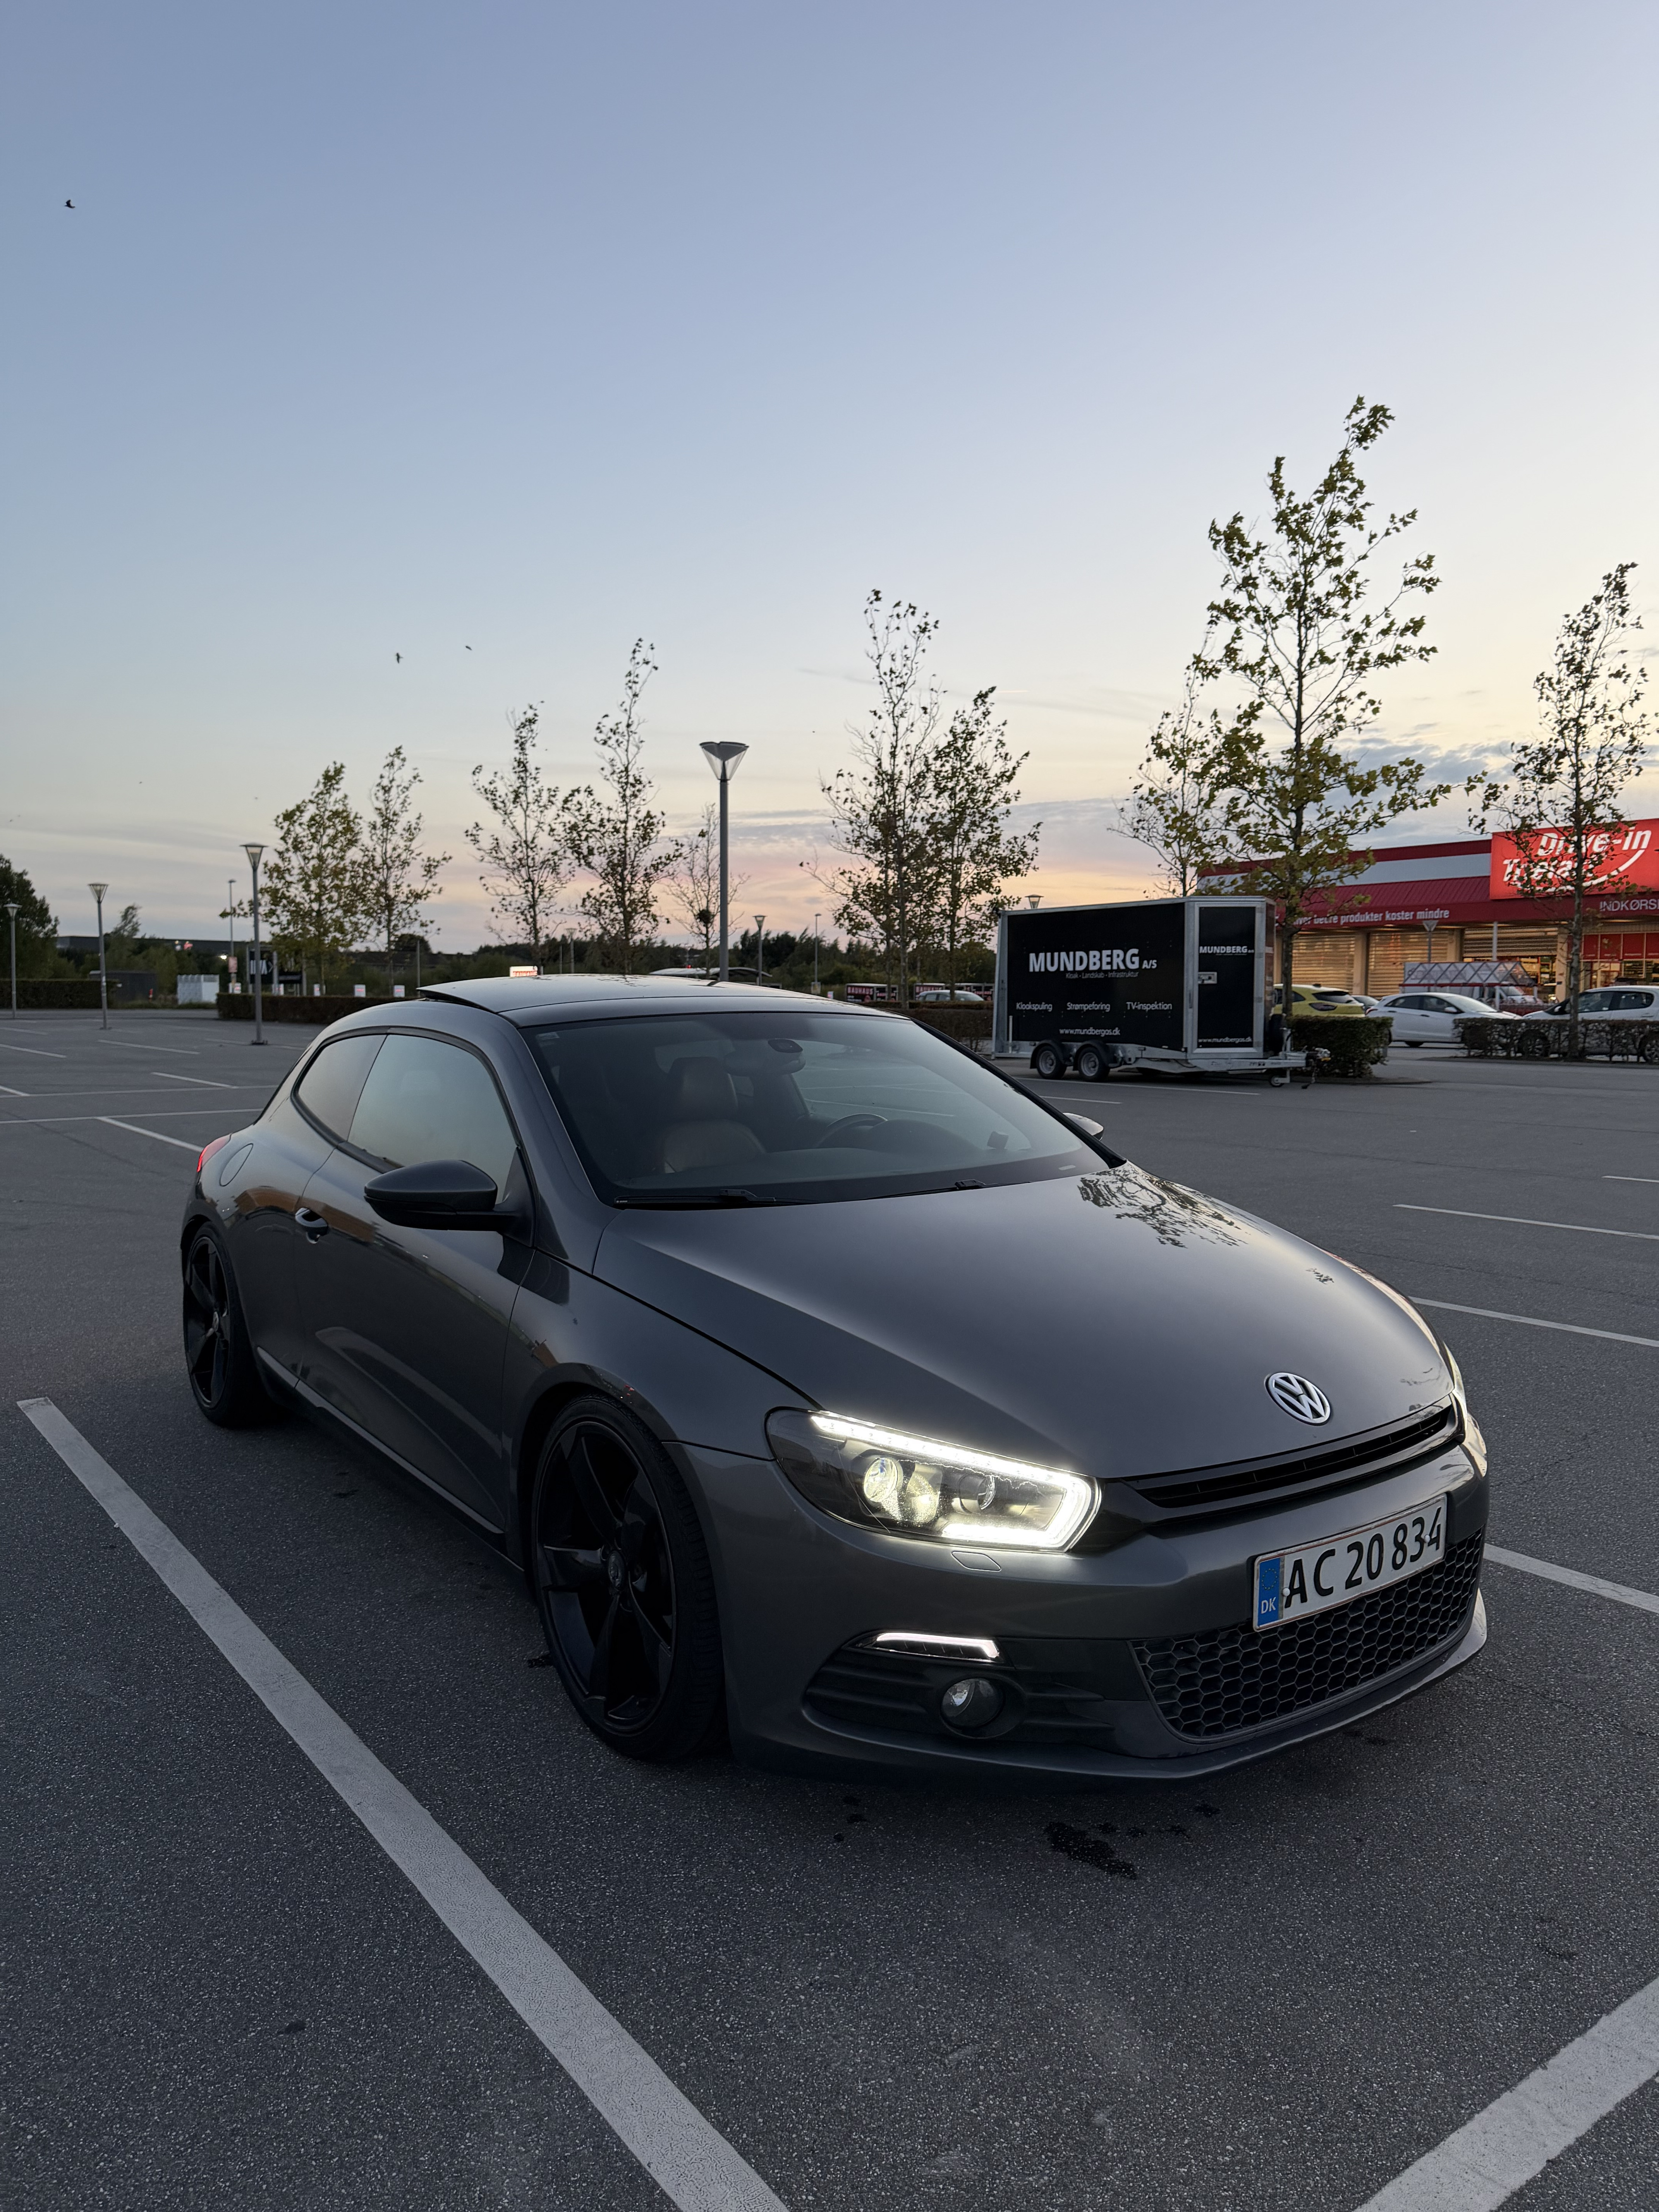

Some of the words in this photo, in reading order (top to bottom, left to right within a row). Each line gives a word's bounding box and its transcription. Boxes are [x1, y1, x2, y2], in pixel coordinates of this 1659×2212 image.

[1600, 898, 1659, 911] INDKØRS
[1340, 912, 1383, 925] produkter
[1385, 911, 1414, 921] koster
[1417, 908, 1449, 919] mindre
[1029, 949, 1139, 972] MUNDBERG
[1142, 960, 1157, 969] A/S
[1066, 1001, 1110, 1012] Strømpeforing
[1126, 1001, 1172, 1012] TV-inspektion
[1285, 1548, 1335, 1608] AC
[1345, 1533, 1384, 1589] 20
[1392, 1506, 1441, 1570] 834
[1261, 1597, 1276, 1614] DK
